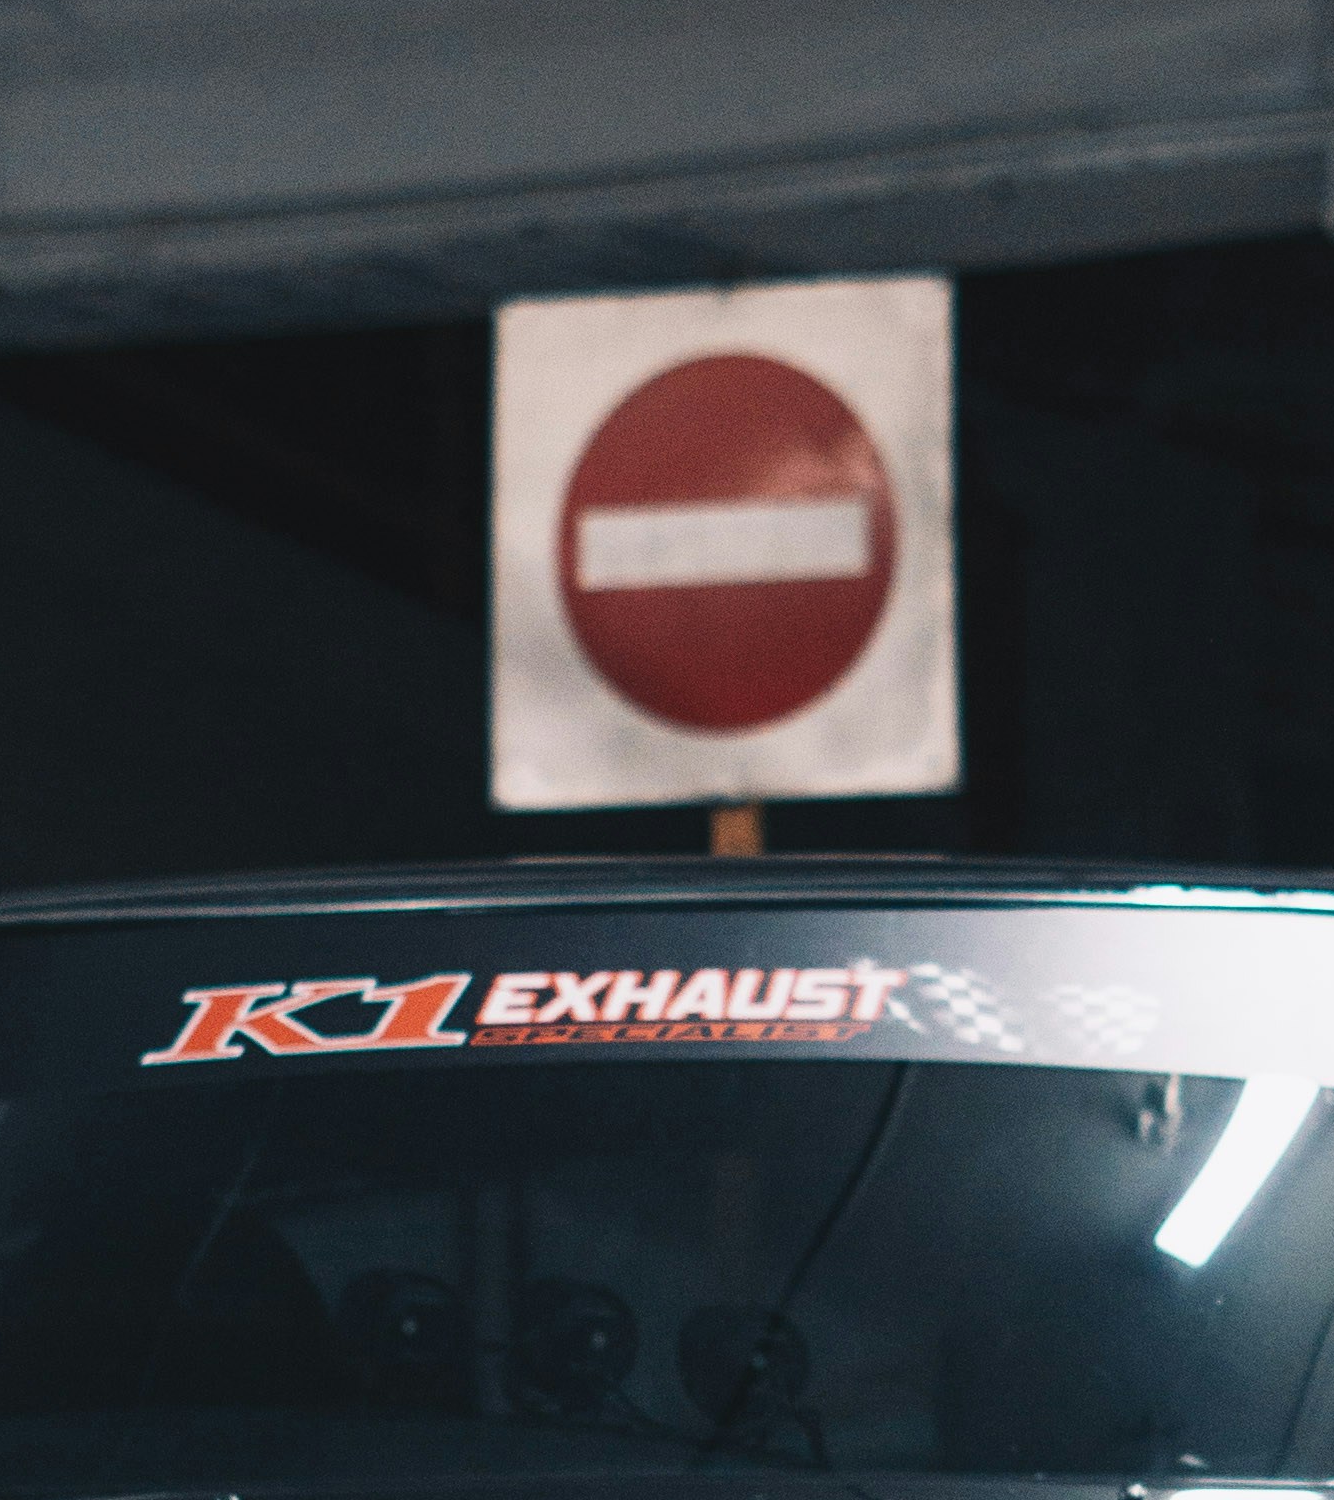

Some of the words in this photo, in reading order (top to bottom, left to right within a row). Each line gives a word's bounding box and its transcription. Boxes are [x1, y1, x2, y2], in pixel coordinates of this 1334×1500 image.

[140, 972, 471, 1065] K1
[475, 968, 907, 1025] EXHAUST
[472, 1022, 870, 1045] SPECIALIST
